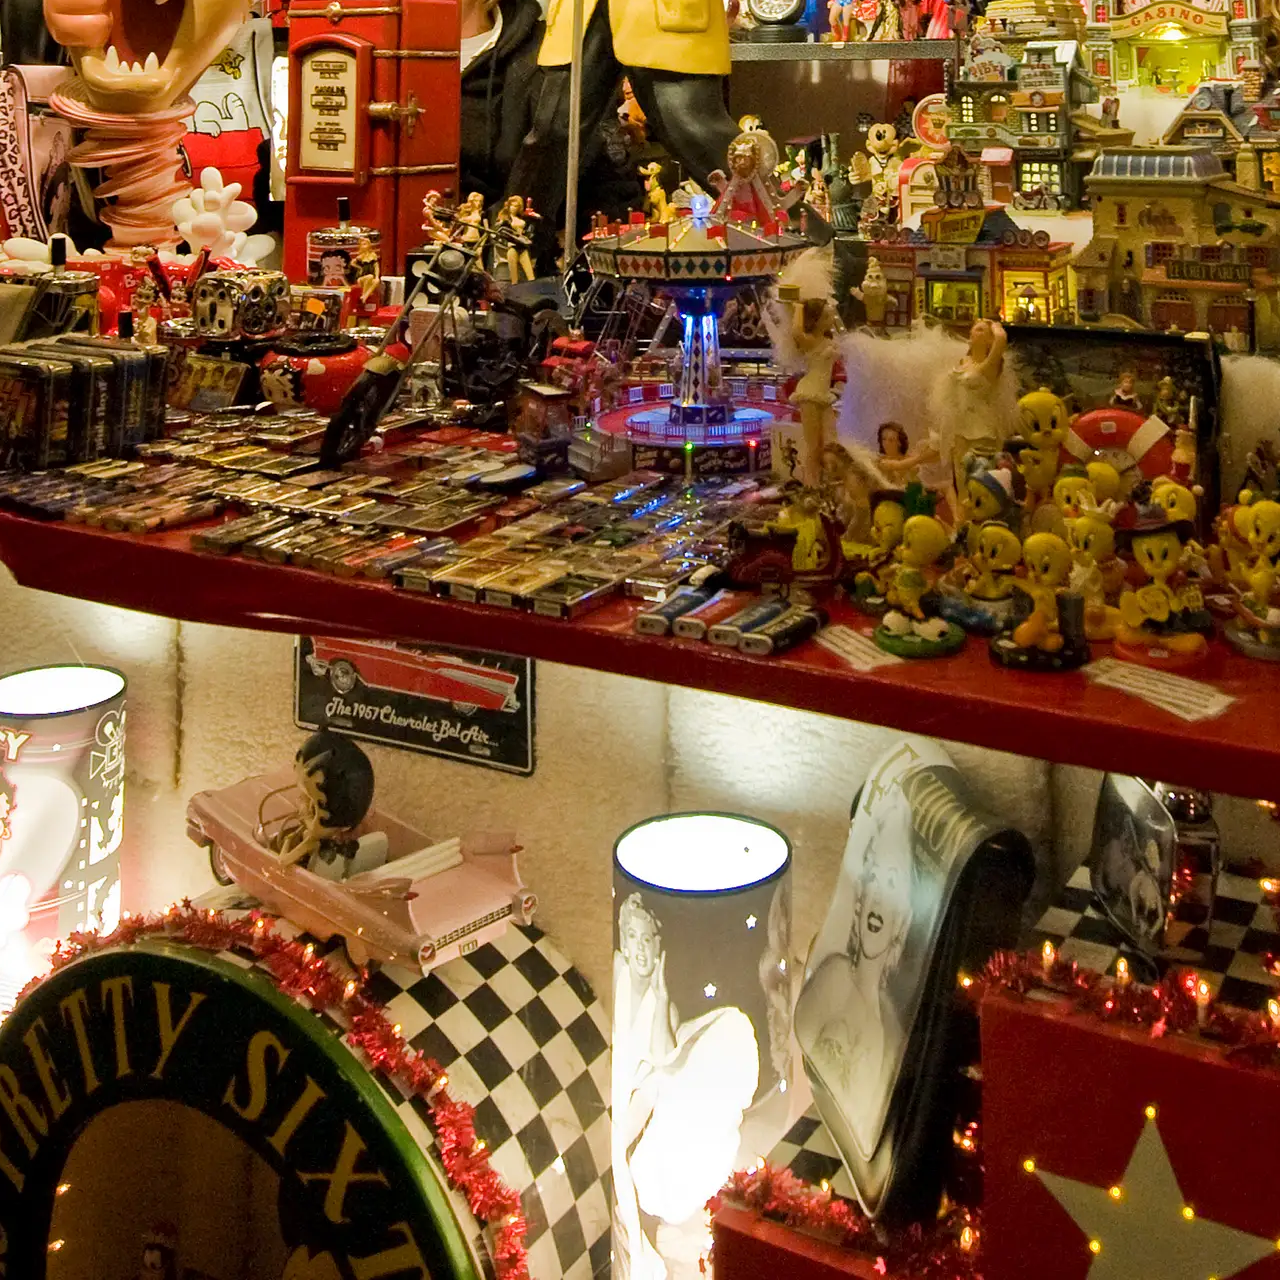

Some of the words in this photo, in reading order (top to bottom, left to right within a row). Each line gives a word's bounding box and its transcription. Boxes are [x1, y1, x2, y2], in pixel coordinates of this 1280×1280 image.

[1130, 7, 1204, 26] CASINO
[325, 696, 352, 717] The
[352, 702, 380, 720] 1957
[379, 705, 439, 734] Chevrolet
[433, 719, 461, 742] Bel
